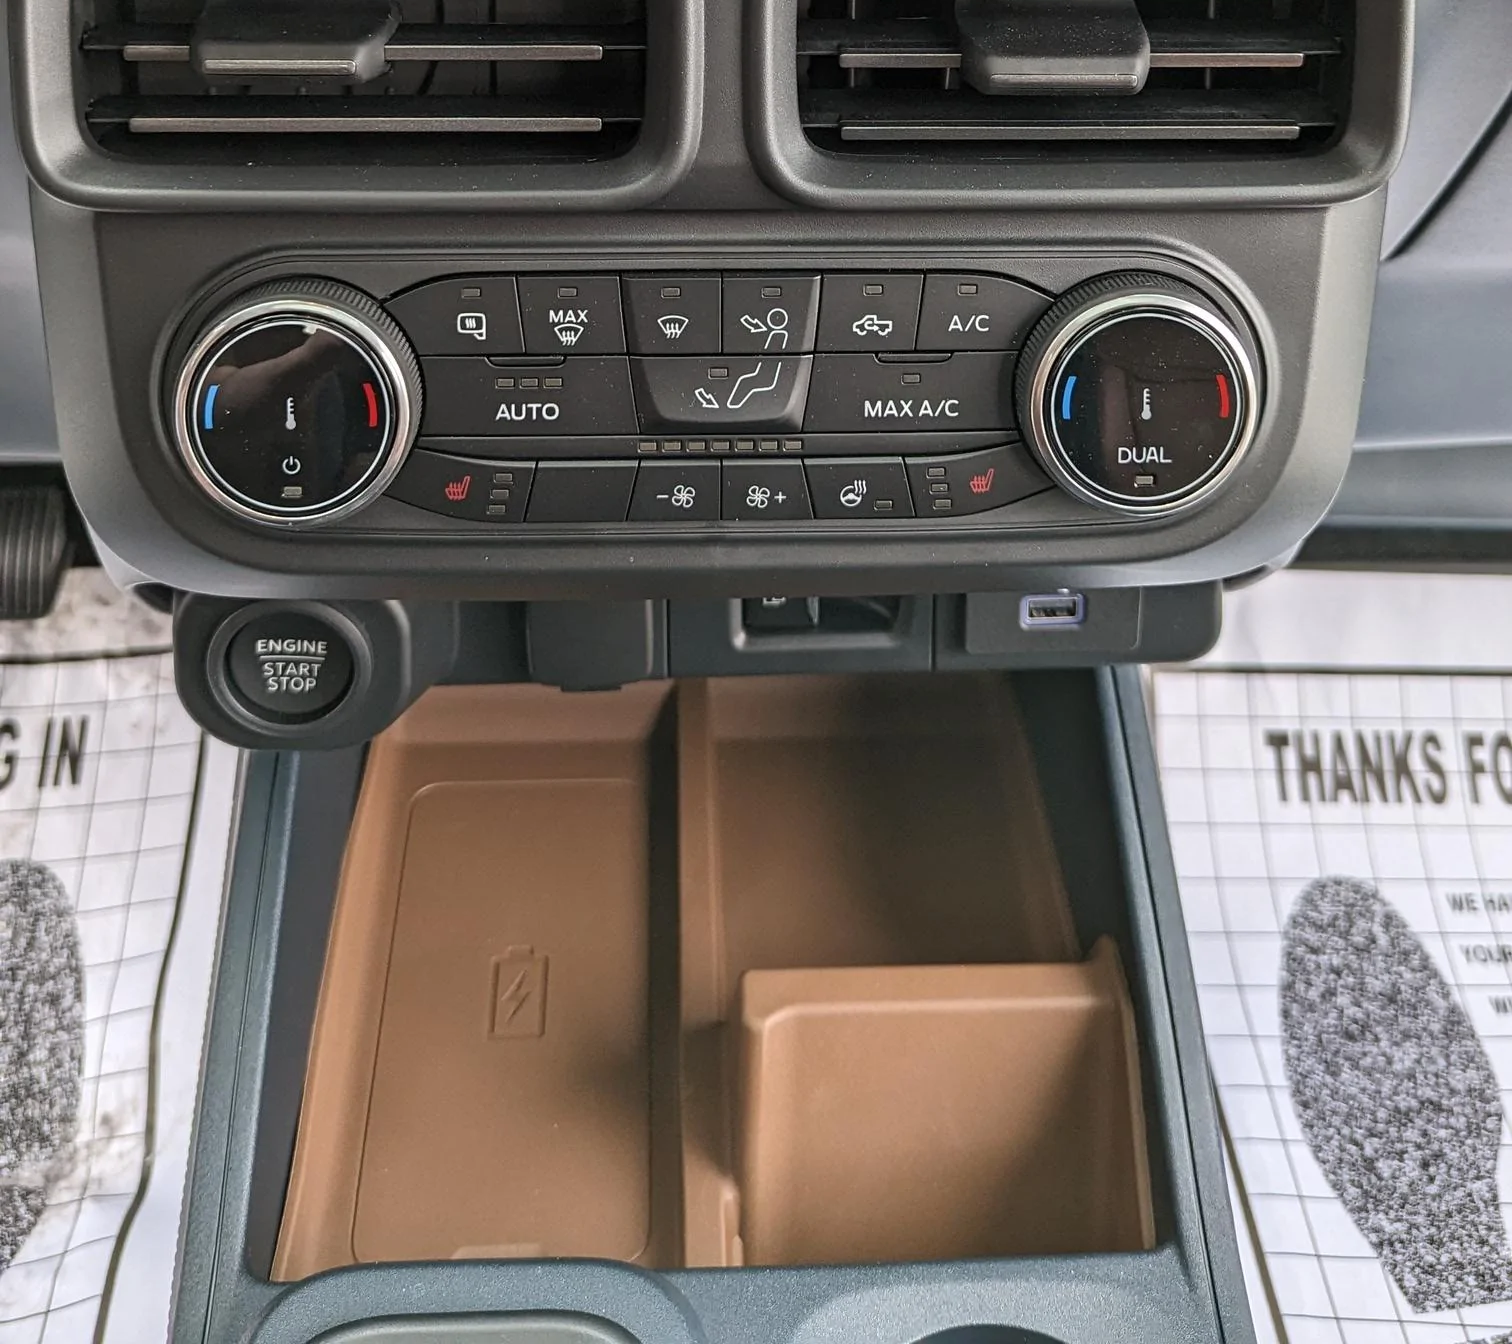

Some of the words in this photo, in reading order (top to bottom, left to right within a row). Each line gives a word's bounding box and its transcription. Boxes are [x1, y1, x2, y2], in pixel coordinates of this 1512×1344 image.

[549, 309, 588, 323] MAX
[948, 315, 990, 332] A/C
[495, 403, 560, 420] AUTO
[864, 400, 914, 417] MAX
[919, 400, 959, 417] A/C
[1117, 447, 1172, 464] DUAL
[256, 639, 328, 654] ENGINE
[262, 662, 321, 677] START
[267, 676, 317, 692] STOP
[37, 716, 90, 787] IN
[1264, 728, 1447, 803] THANKS
[1446, 892, 1479, 912] WE
